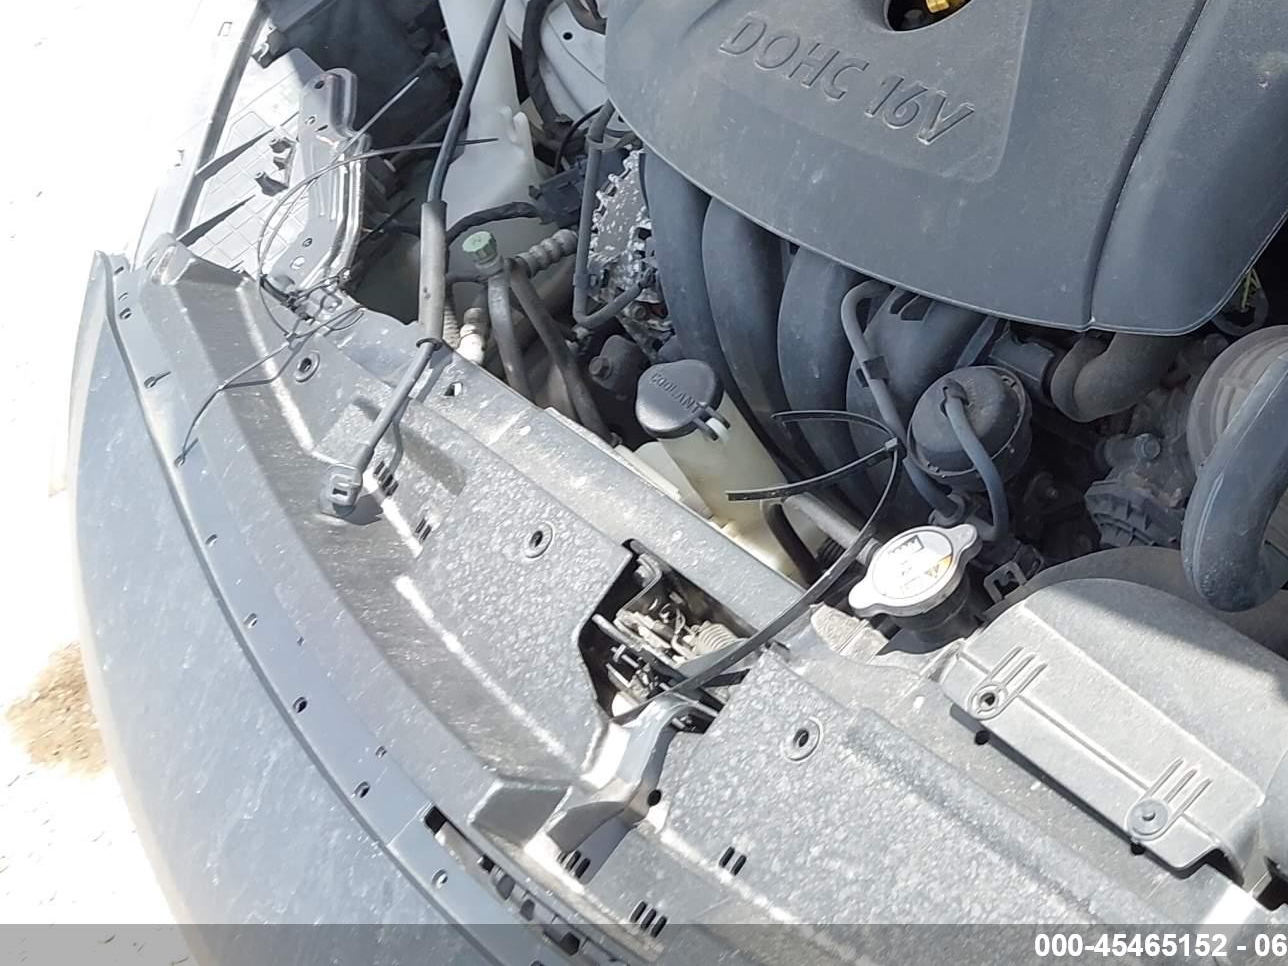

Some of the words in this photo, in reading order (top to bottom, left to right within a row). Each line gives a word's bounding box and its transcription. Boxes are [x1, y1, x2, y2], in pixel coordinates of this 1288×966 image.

[718, 12, 871, 101] DOHC
[864, 73, 975, 145] 16V
[649, 371, 704, 414] COOLANT
